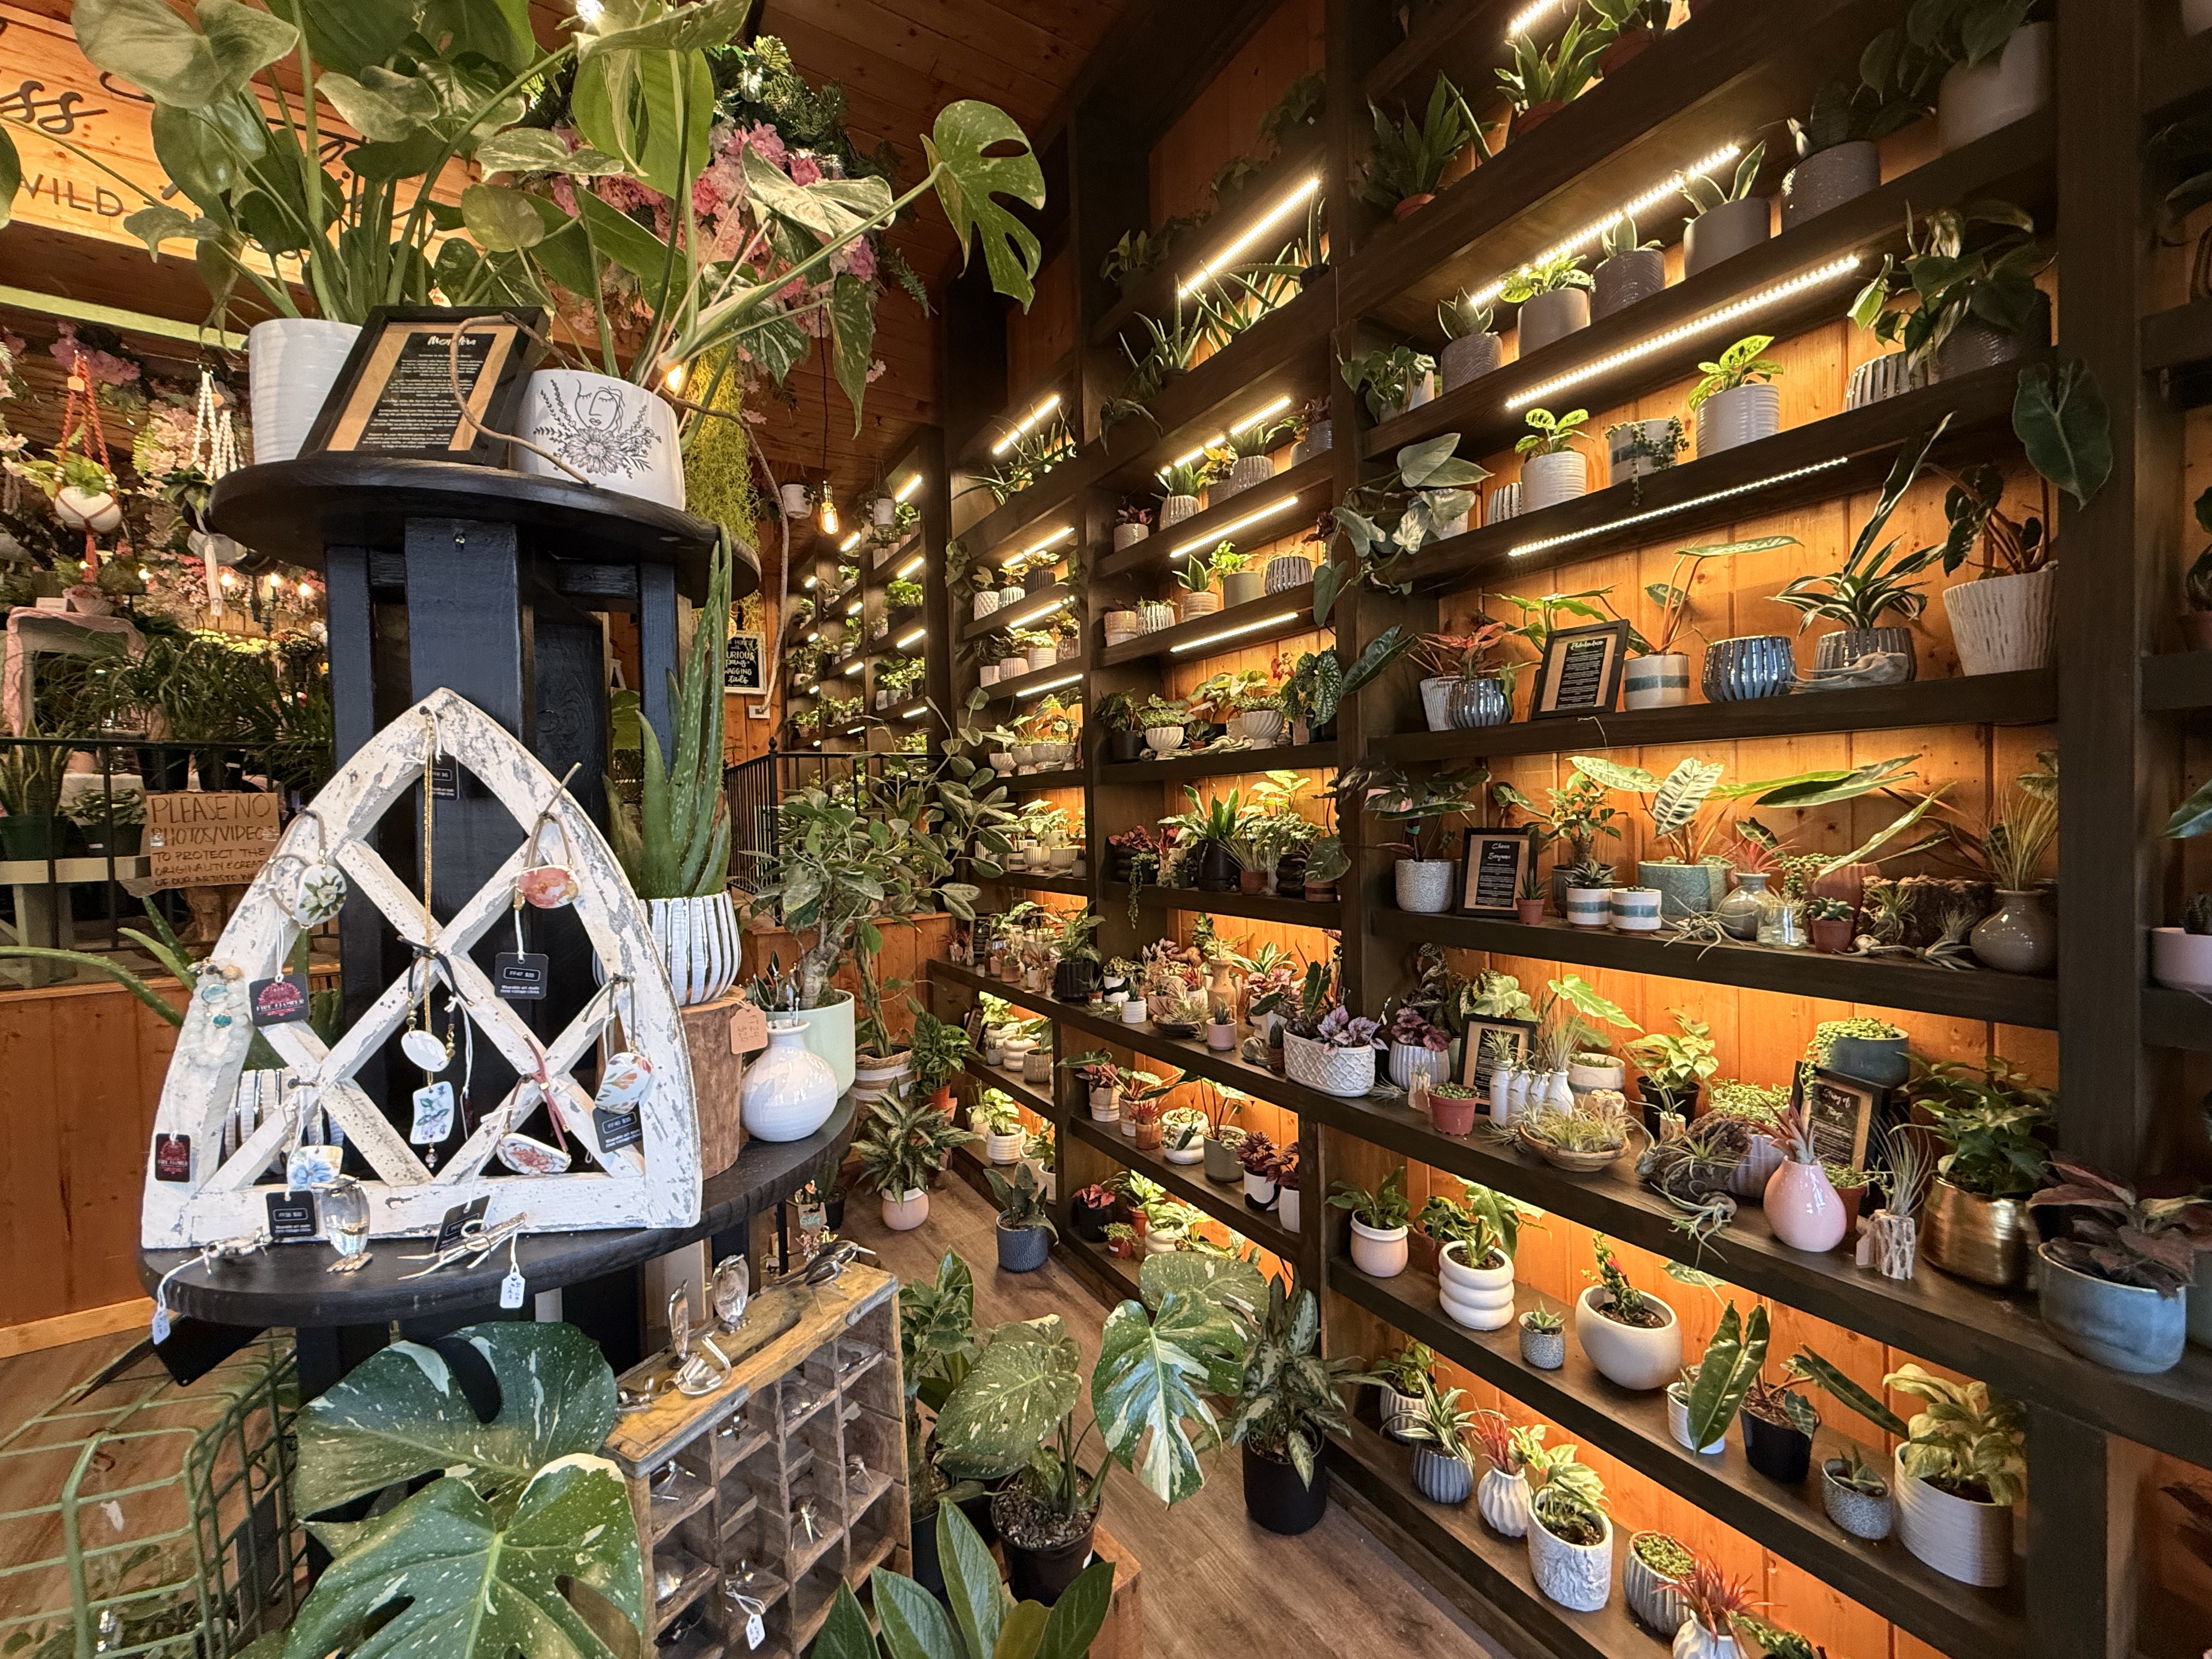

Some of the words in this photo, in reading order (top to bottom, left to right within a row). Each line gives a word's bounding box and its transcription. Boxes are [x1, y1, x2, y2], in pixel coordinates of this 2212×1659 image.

[0, 80, 109, 134] ss
[726, 651, 755, 661] URIOUS
[728, 675, 749, 684] tails
[151, 795, 229, 823] PLEASE
[235, 794, 271, 819] NO
[153, 851, 171, 862] TO
[176, 849, 233, 862] PROTECT
[239, 848, 267, 857] THE
[154, 863, 223, 876] ORIGINALITY
[234, 860, 264, 870] CREAT
[154, 878, 170, 887] OF
[172, 876, 194, 885] OUR
